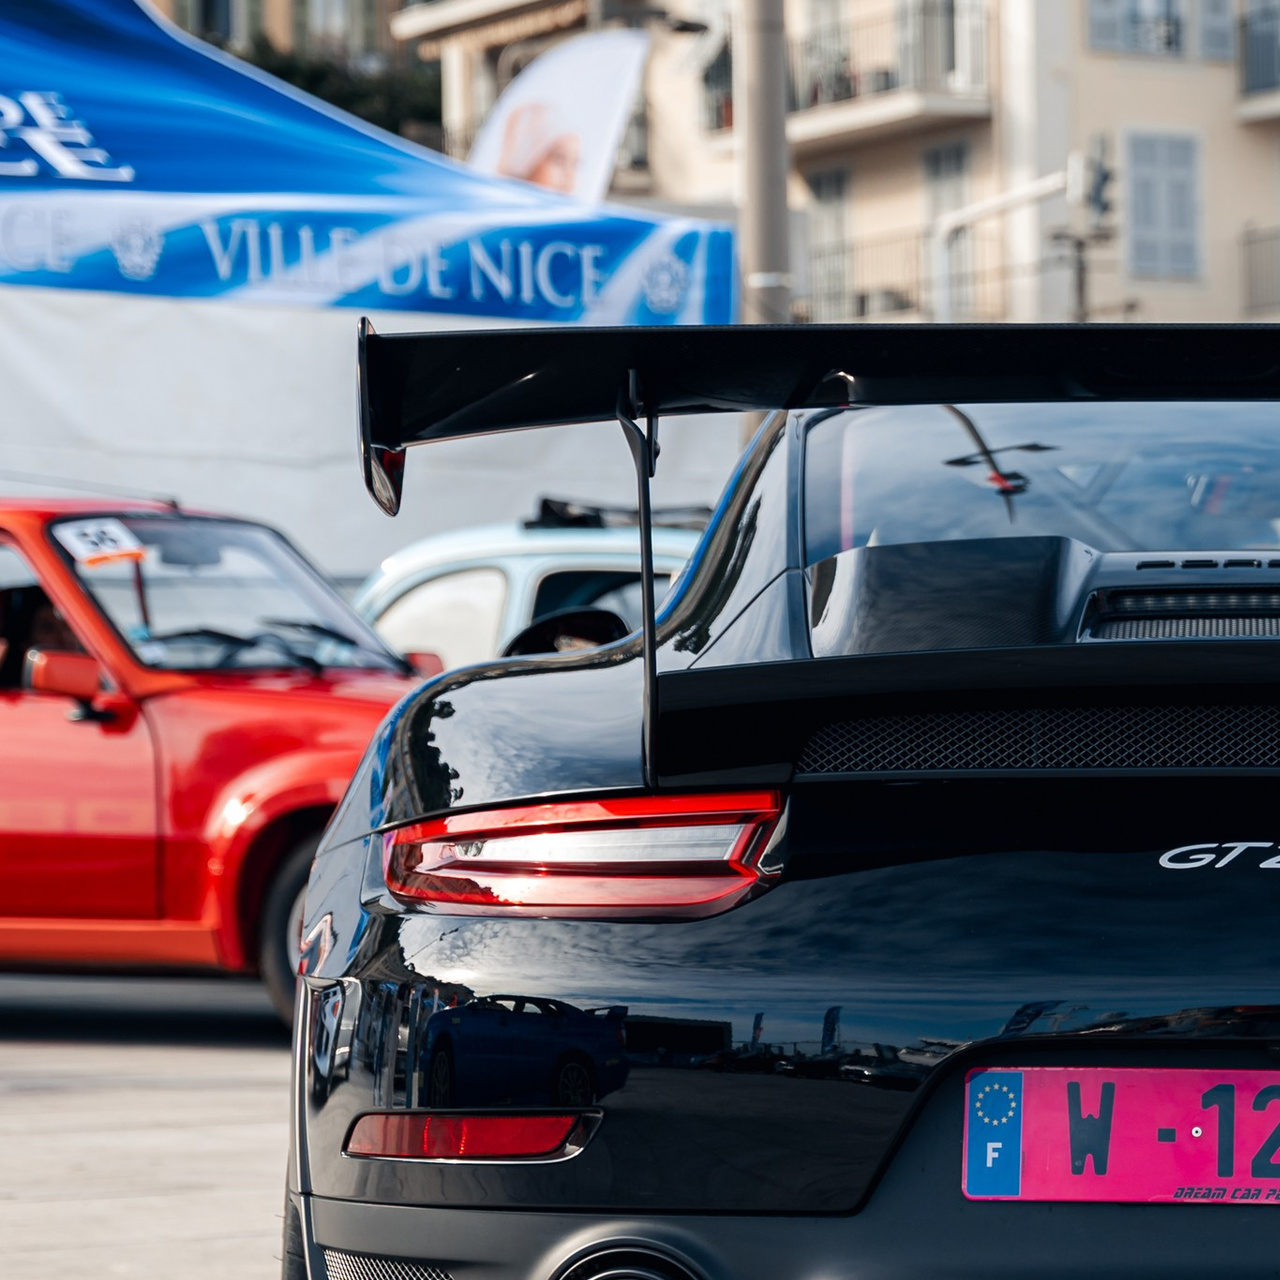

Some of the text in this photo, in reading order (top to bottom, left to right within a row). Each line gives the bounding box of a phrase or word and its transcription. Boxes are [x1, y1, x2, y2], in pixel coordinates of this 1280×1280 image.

[201, 219, 611, 309] VILLE DE NICE
[985, 1142, 1003, 1168] F
[1173, 1186, 1227, 1199] DREAM
[1230, 1187, 1261, 1200] CAR
